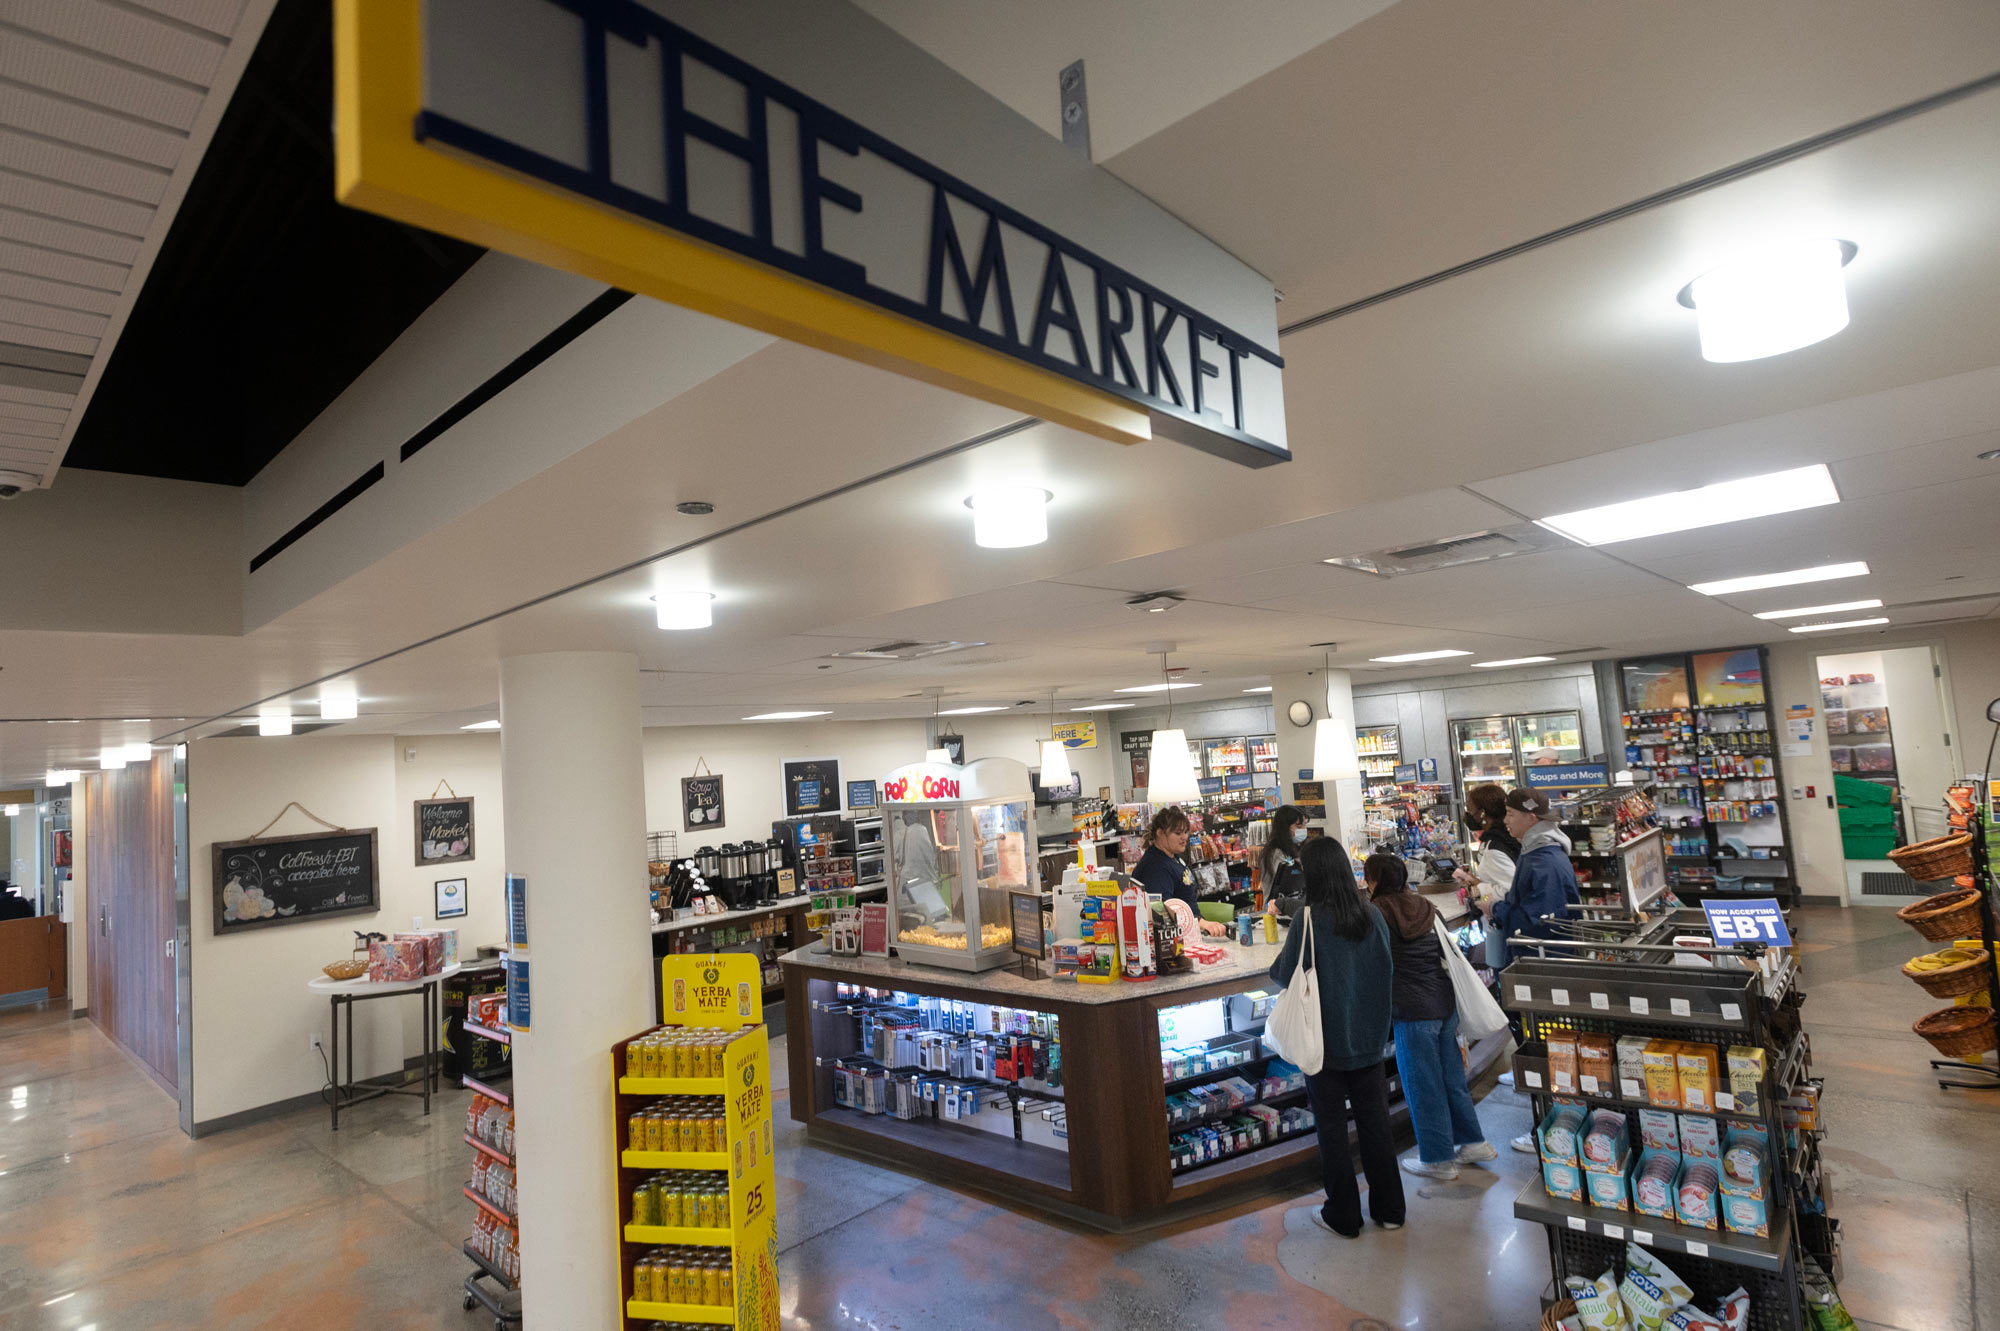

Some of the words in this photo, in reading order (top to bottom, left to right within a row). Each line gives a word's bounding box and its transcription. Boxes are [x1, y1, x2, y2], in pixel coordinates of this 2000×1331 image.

[553, 0, 867, 284] THE
[926, 183, 1248, 430] MARKET
[1054, 730, 1076, 739] HERE
[1530, 772, 1558, 782] Soups
[1560, 772, 1578, 780] and
[1580, 770, 1604, 779] More
[689, 780, 712, 794] Soup
[884, 776, 908, 802] POP
[922, 776, 960, 799] CORN
[694, 793, 712, 806] Tea
[423, 806, 462, 820] Welcome
[429, 823, 469, 839] Market
[288, 866, 335, 882] accepted
[336, 864, 360, 876] here
[1158, 926, 1183, 941] TCHO
[1711, 916, 1779, 939] EBT
[692, 986, 731, 997] YERBA
[699, 998, 727, 1007] MATE
[736, 1084, 764, 1112] YERBA
[740, 1098, 760, 1124] MATE
[1628, 1270, 1660, 1300] GOYA
[1622, 1284, 1657, 1315] antain
[1581, 1302, 1608, 1316] ntain
